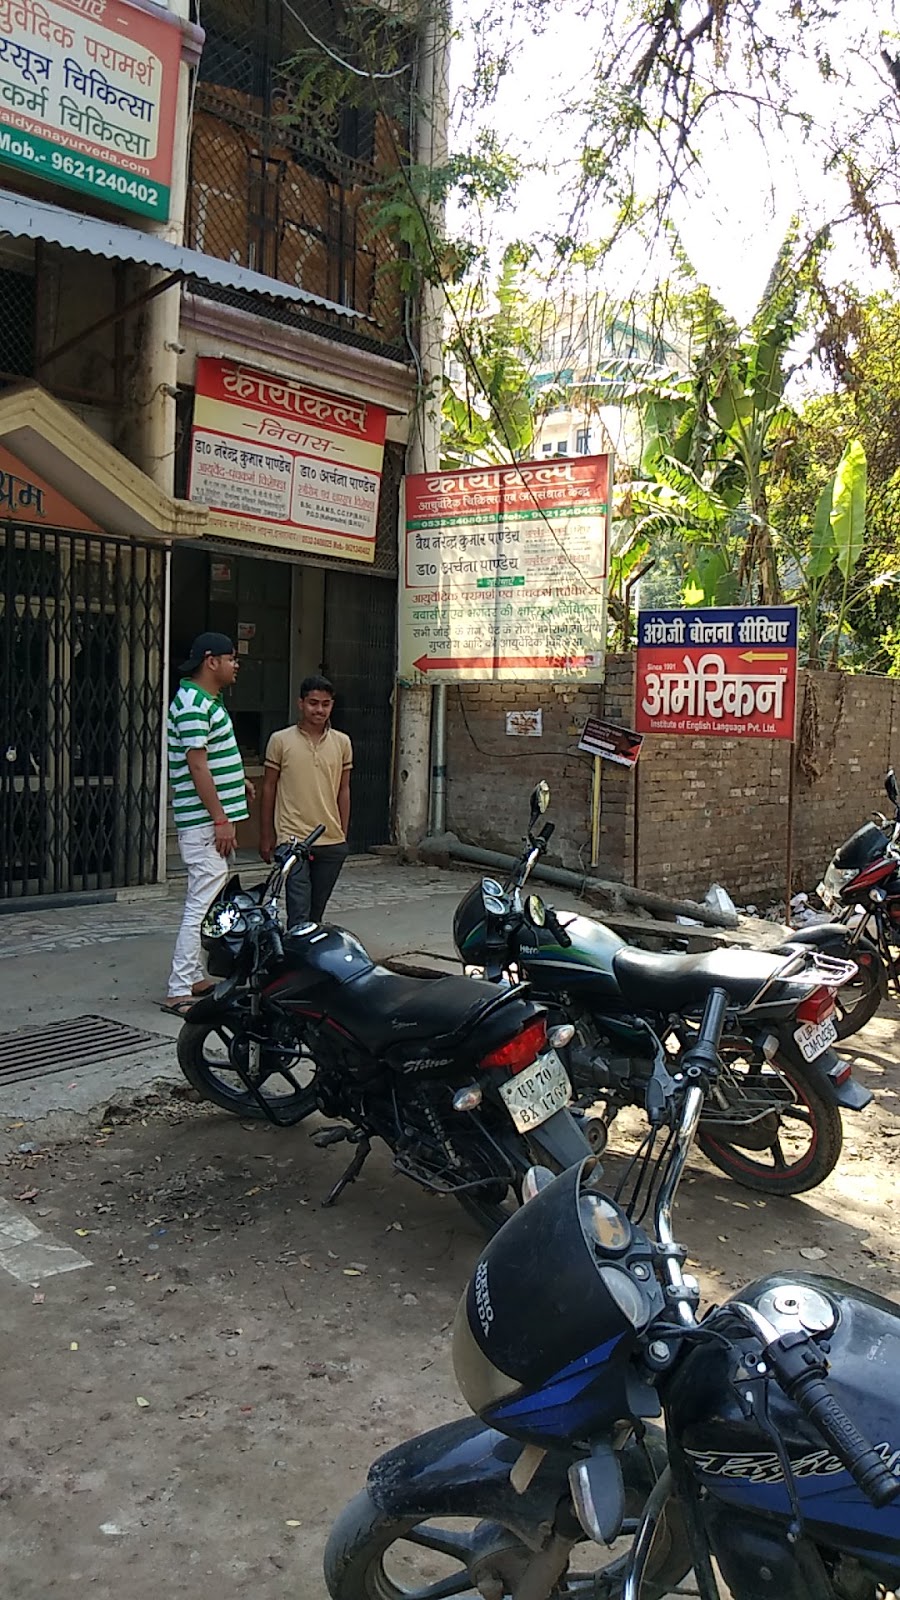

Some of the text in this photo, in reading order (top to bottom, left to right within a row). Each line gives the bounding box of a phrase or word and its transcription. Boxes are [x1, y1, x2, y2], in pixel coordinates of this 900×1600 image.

[84, 35, 156, 87] परामर्श
[63, 57, 154, 122] चिकित्सा
[59, 95, 150, 158] चिकित्सा
[51, 152, 158, 206] 9621240402
[240, 450, 263, 469] कुमार
[425, 462, 576, 494] कायाकल्प
[418, 498, 461, 513] आयुर्वेदिक
[457, 532, 486, 551] कुमार
[487, 526, 520, 545] पाण्डेय
[644, 616, 790, 644] अंग्रेजी बोलना सीखिए
[647, 663, 662, 671] Since
[641, 653, 786, 719] अमेरिकन
[651, 719, 776, 733] Institute of English Language Pvt. Ltd.
[516, 1068, 552, 1099] UP 70
[519, 1105, 539, 1125] BX
